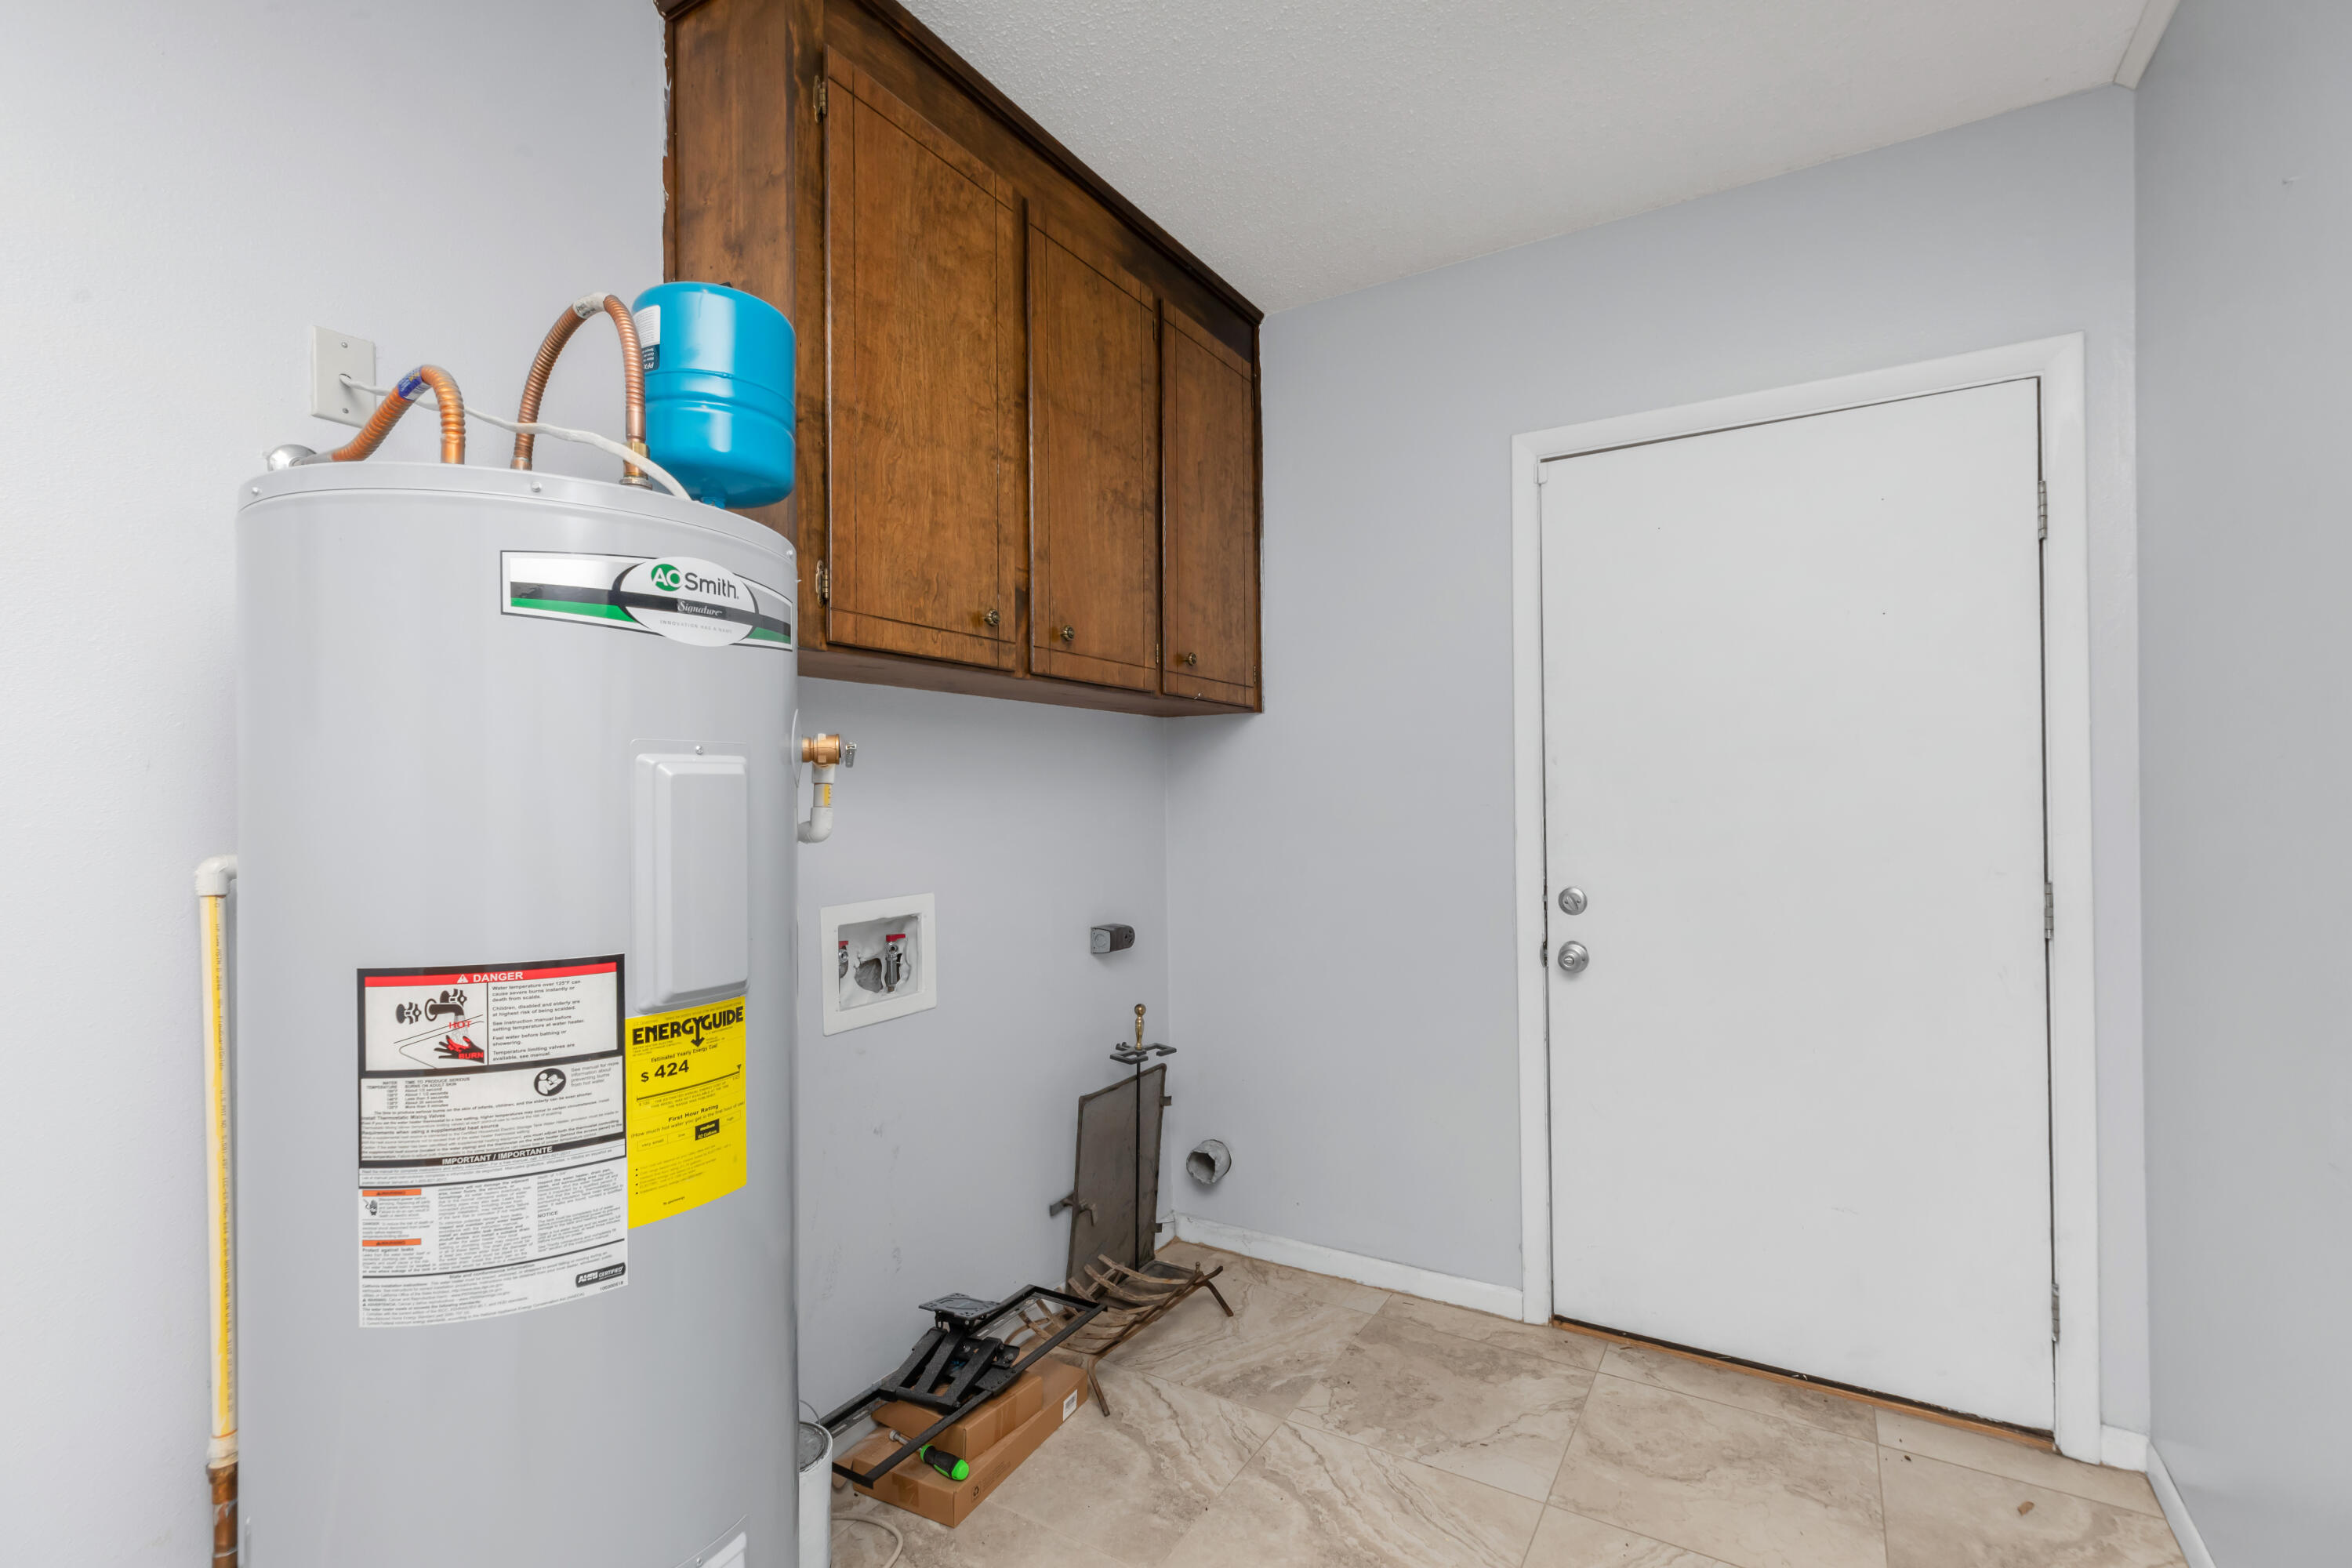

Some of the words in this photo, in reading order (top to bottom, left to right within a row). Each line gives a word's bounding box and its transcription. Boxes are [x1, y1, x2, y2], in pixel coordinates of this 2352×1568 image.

[473, 972, 523, 983] DANGER
[632, 1006, 743, 1047] ENERGYGUIDE
[458, 1051, 484, 1060] BURN
[652, 1051, 675, 1062] Estimated
[693, 1046, 707, 1054] Energy
[641, 1072, 649, 1083] $
[654, 1059, 689, 1078] 424
[701, 1105, 719, 1114] Rating
[442, 1154, 492, 1165] IMPORTANT
[498, 1145, 553, 1160] IMPORTANTE
[599, 1266, 622, 1277] CERTIFIED
